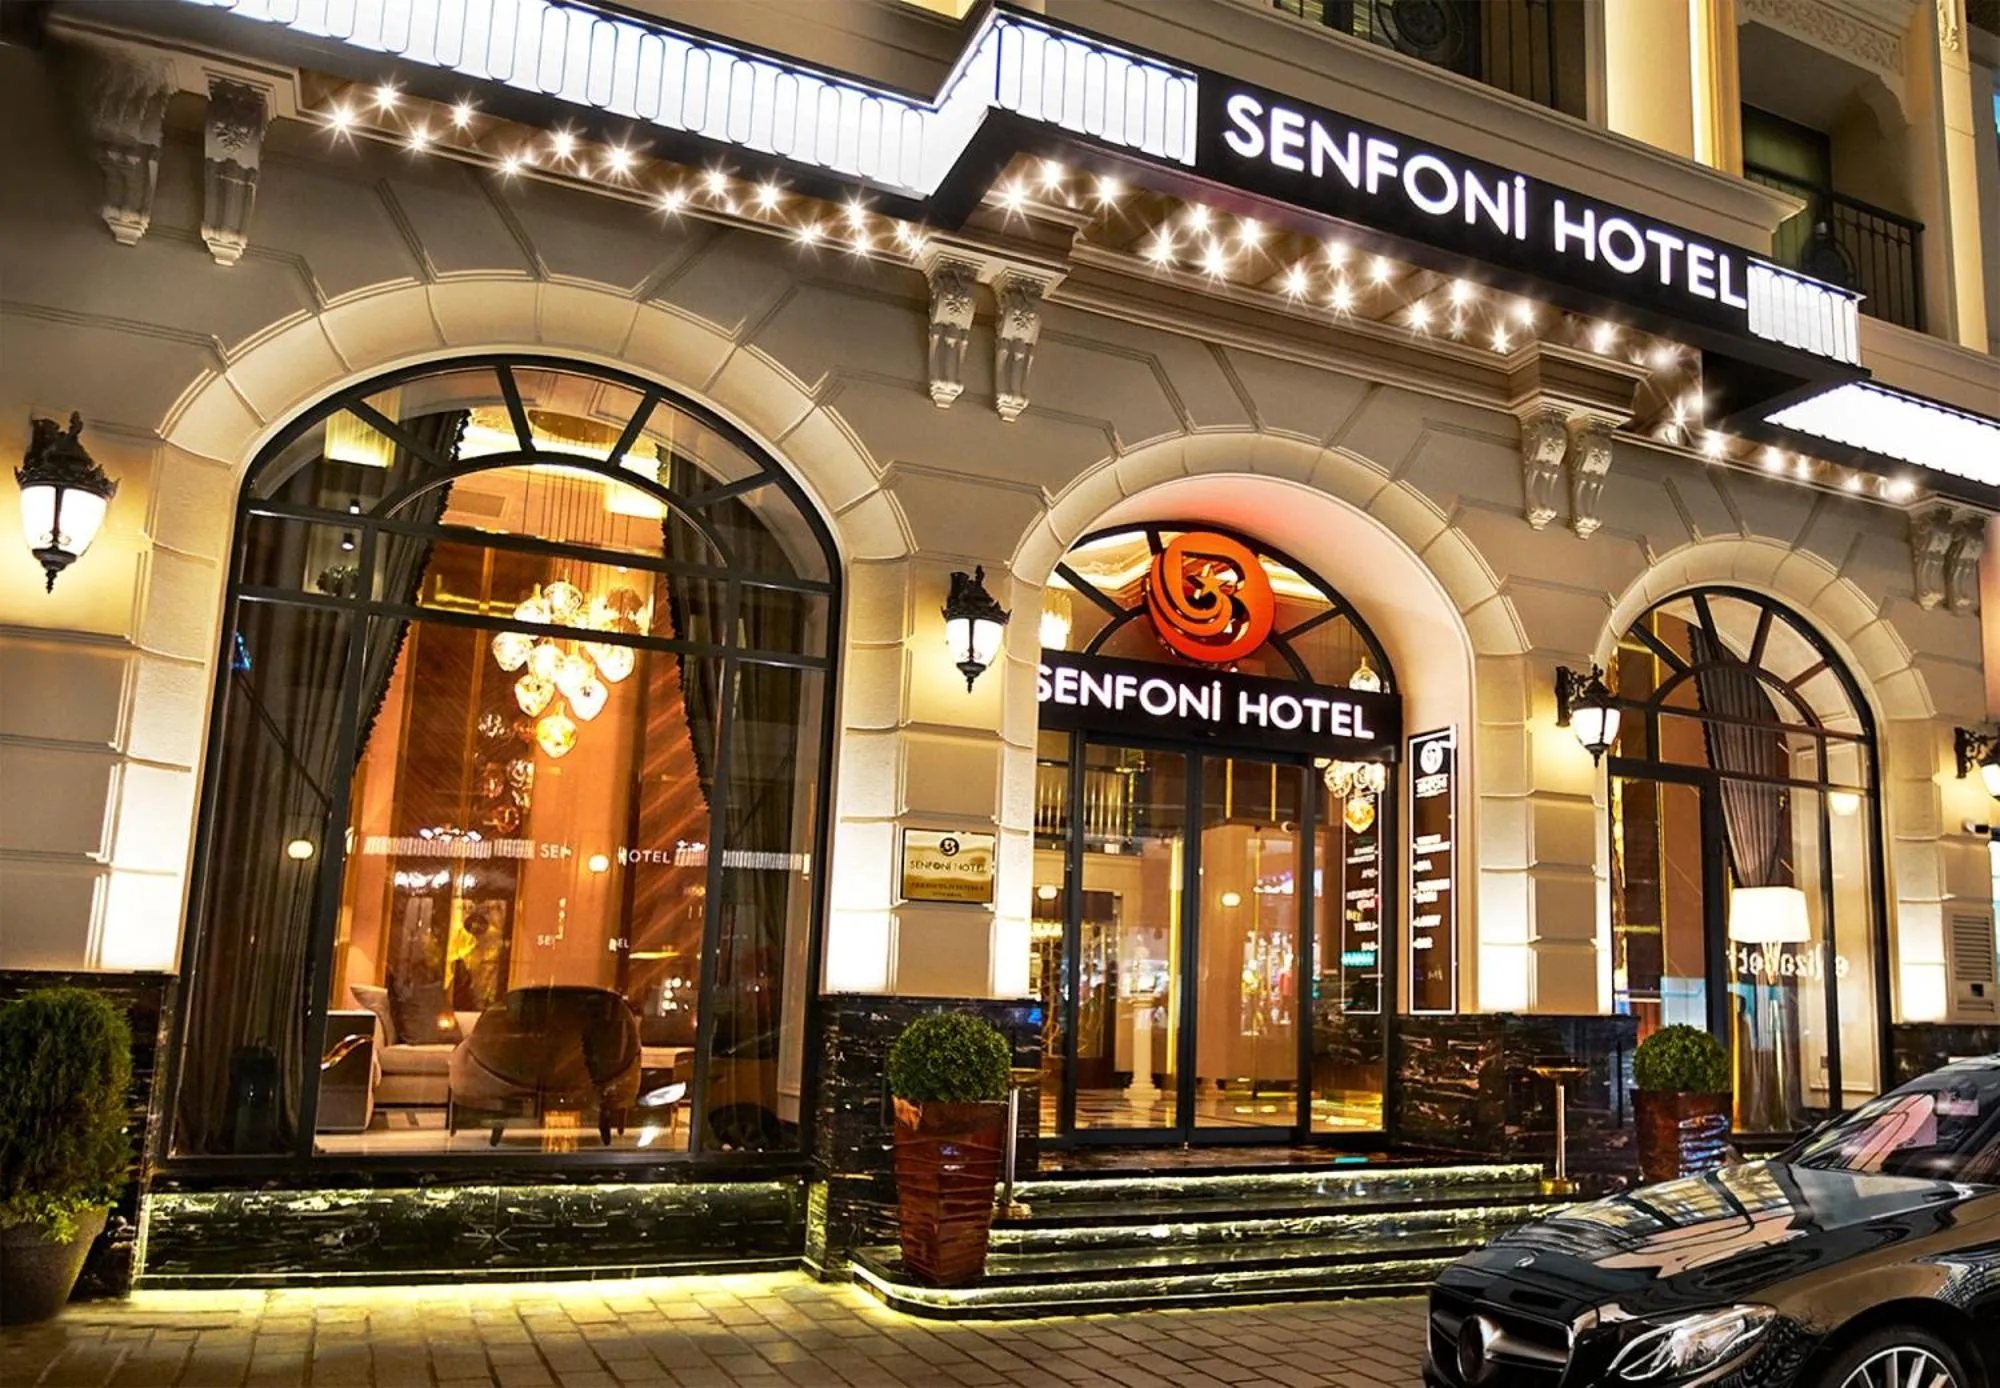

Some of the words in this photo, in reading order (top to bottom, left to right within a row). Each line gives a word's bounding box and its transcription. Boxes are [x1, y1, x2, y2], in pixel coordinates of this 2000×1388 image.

[1223, 94, 1527, 240] SENFONİ
[1554, 198, 1747, 309] HOTEL
[1239, 691, 1375, 740] HOTEL
